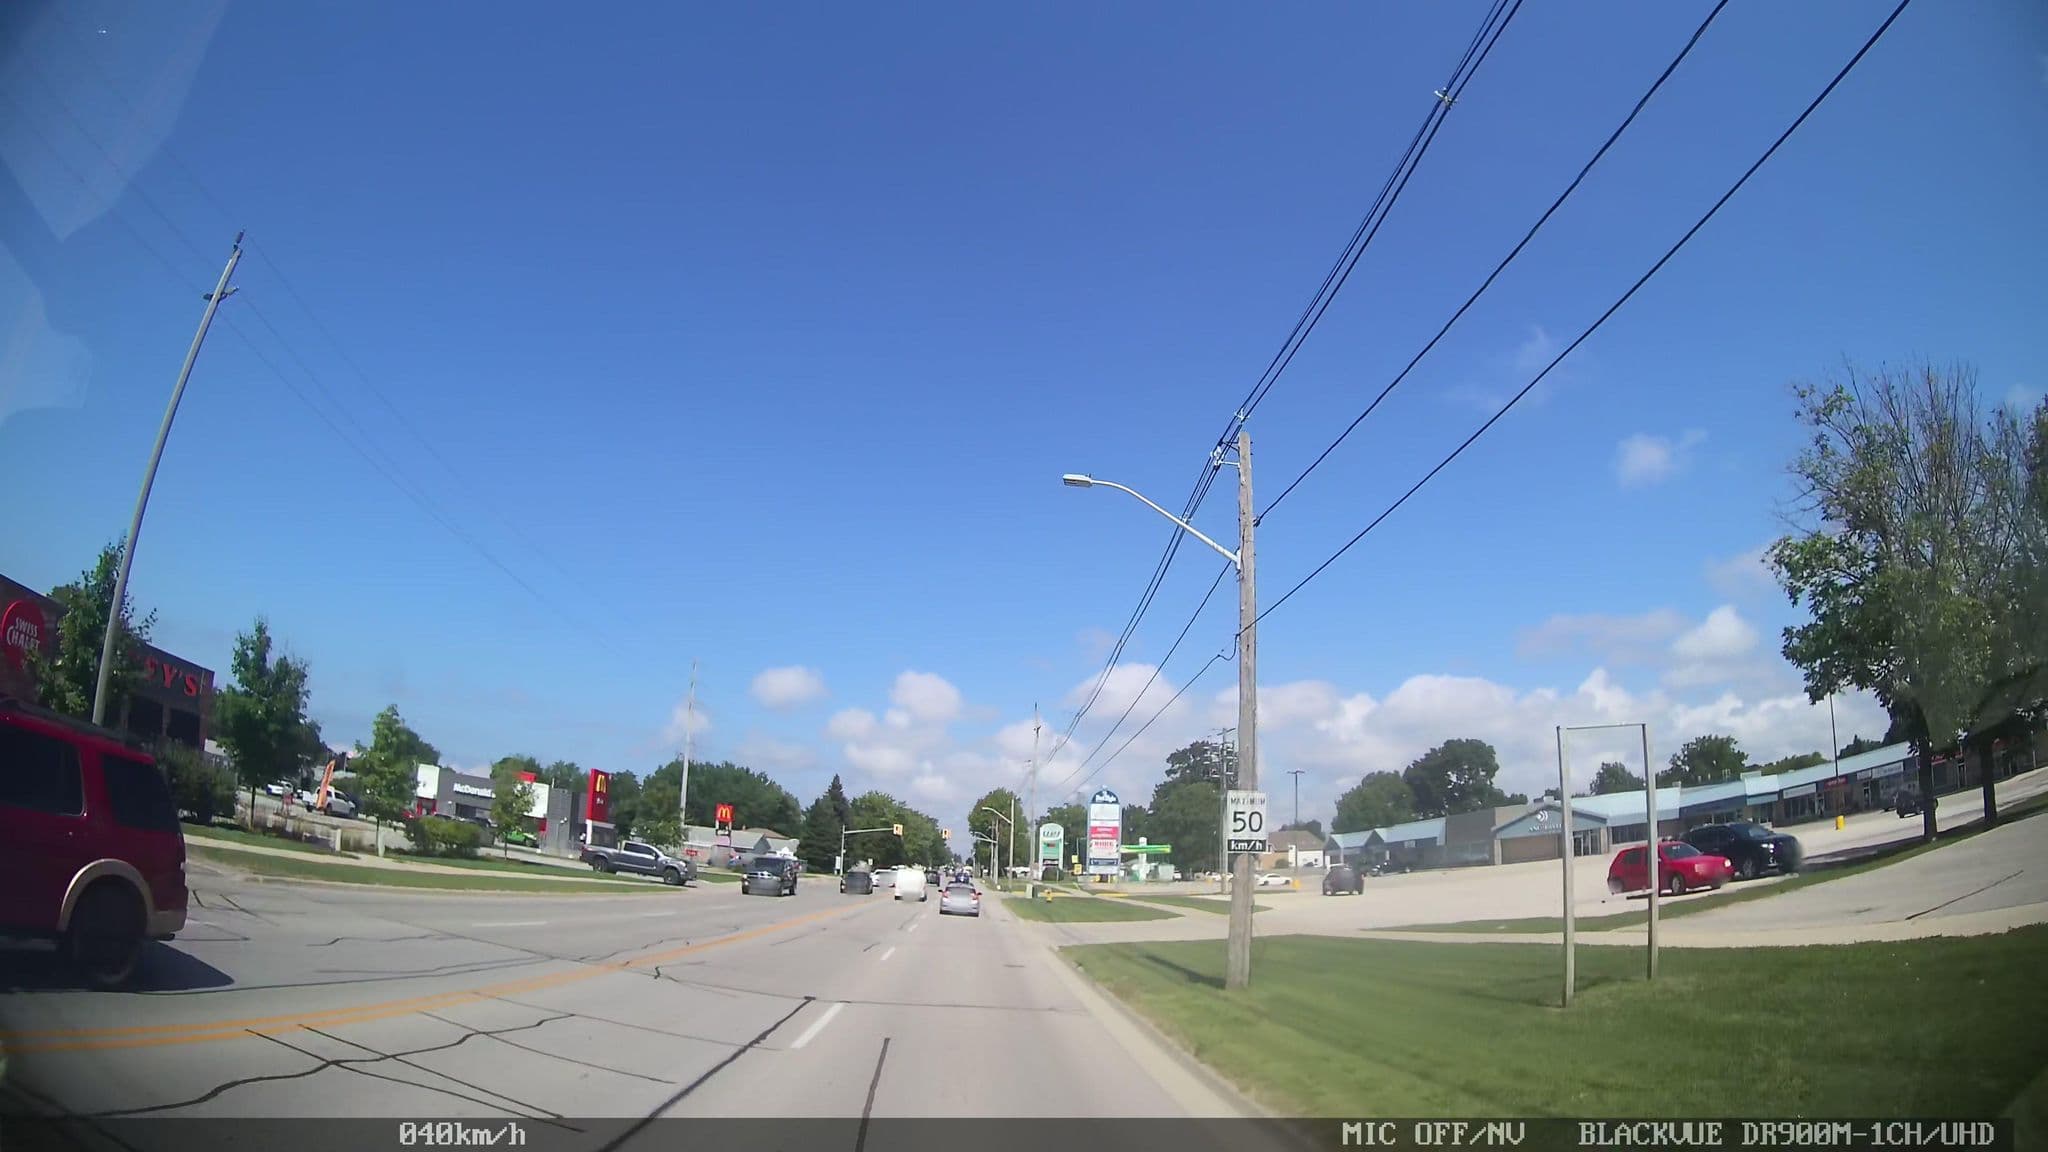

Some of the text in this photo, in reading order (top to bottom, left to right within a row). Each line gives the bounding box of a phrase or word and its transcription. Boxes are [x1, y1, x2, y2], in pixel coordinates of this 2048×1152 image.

[15, 617, 38, 638] SWISS
[1232, 811, 1263, 833] 50
[1231, 840, 1263, 851] km/h
